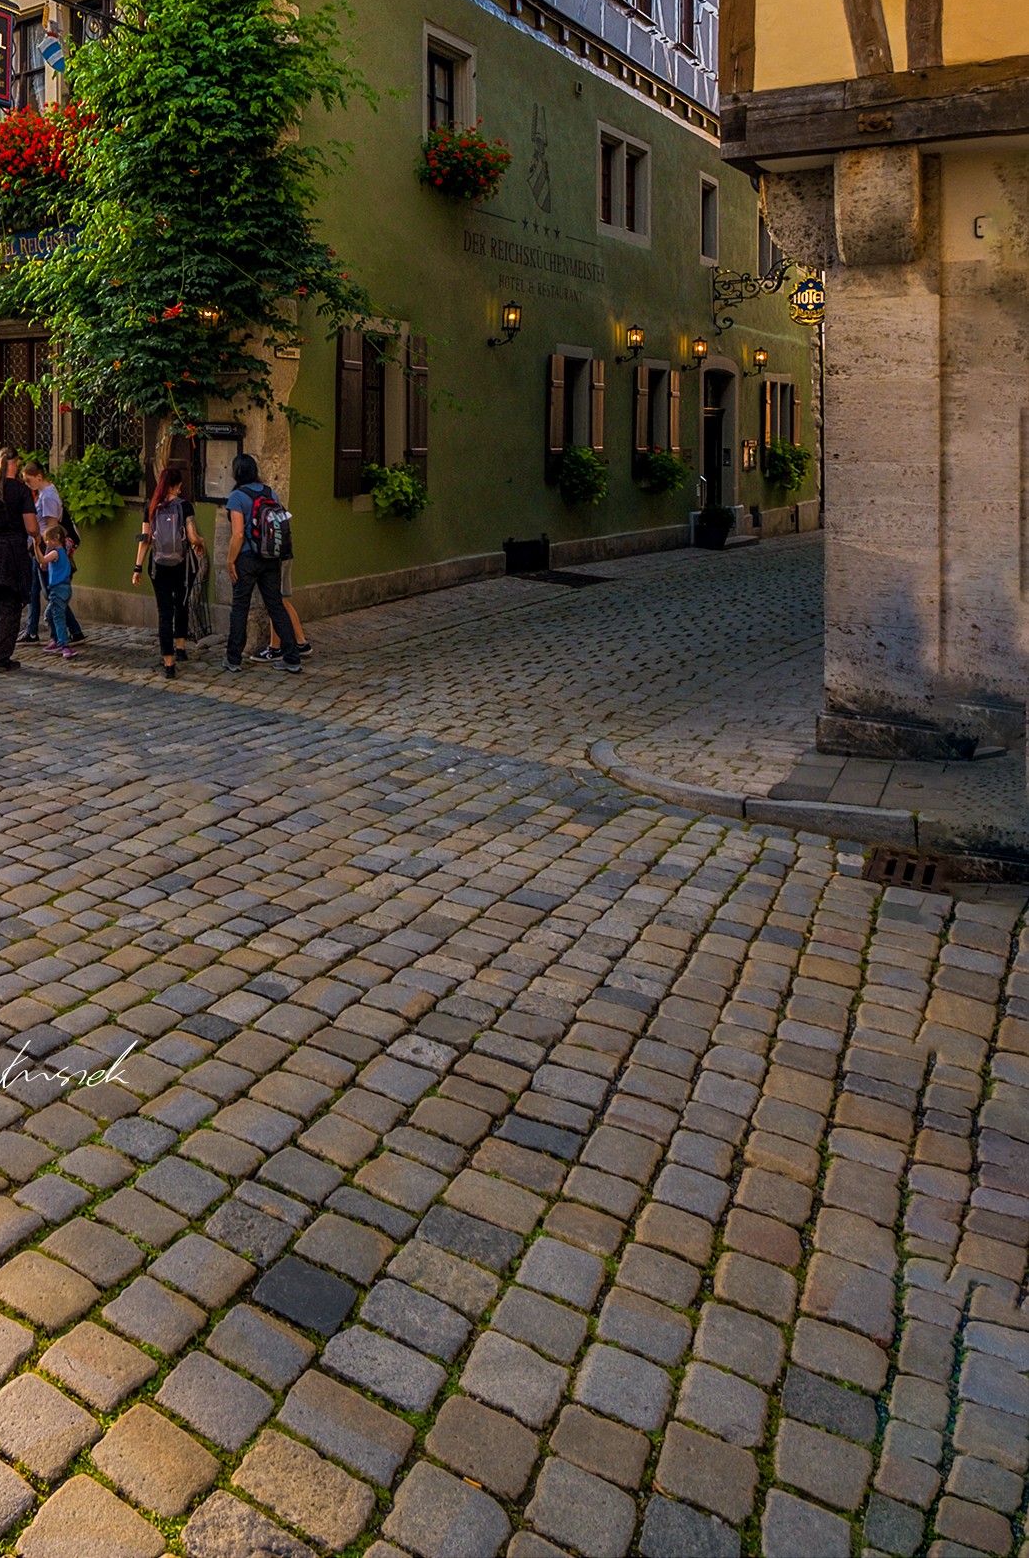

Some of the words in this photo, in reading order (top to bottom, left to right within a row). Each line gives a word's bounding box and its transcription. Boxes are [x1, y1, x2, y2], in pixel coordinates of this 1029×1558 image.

[463, 230, 486, 256] DER
[490, 237, 606, 284] REICHSKÜCHENMEISTER
[498, 274, 526, 293] HOTEL
[537, 282, 583, 304] RESTAURANT
